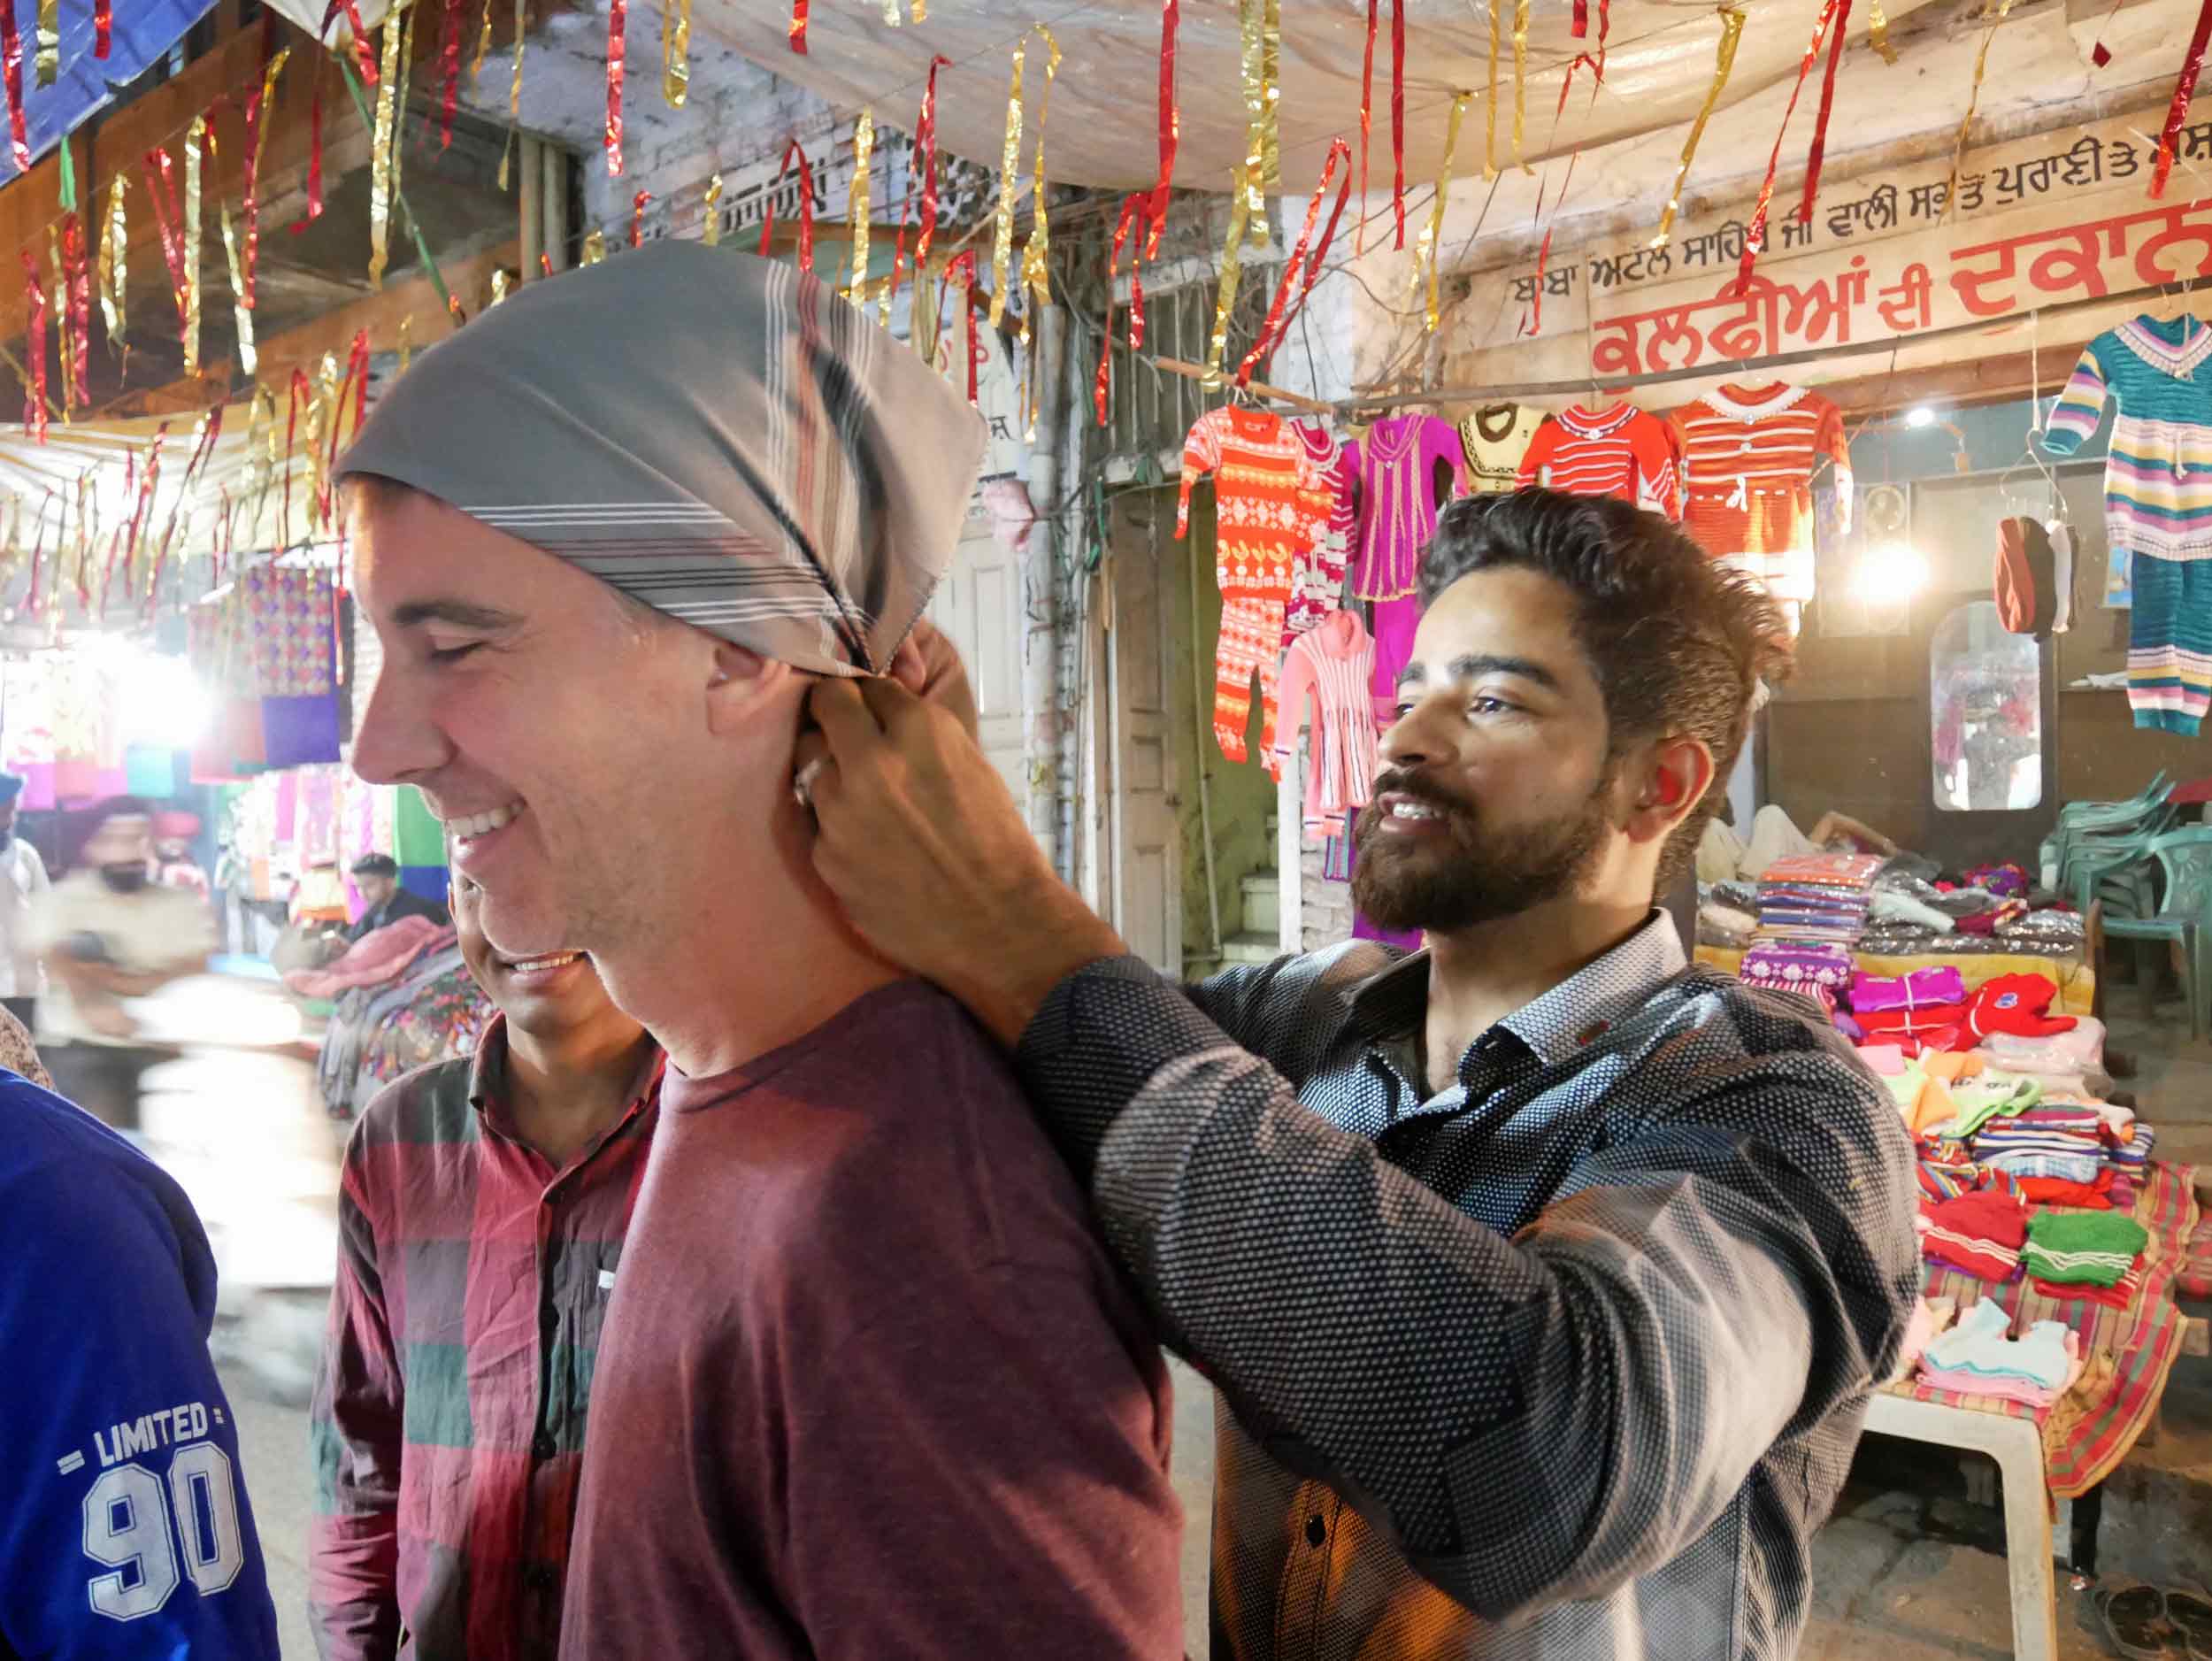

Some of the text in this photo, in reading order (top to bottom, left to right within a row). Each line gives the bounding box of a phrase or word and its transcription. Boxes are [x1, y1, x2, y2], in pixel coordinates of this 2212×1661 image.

[1510, 265, 1579, 303] ਬਾਬਾ
[1827, 183, 1898, 237] ਵਾਲੀ
[1992, 135, 2104, 204] ਪੁਰਾਣੀ
[2108, 141, 2138, 177] ਤੇ
[1878, 263, 1933, 331] ਦੀ
[93, 1402, 209, 1467] LIMITED
[82, 1440, 244, 1622] 90
